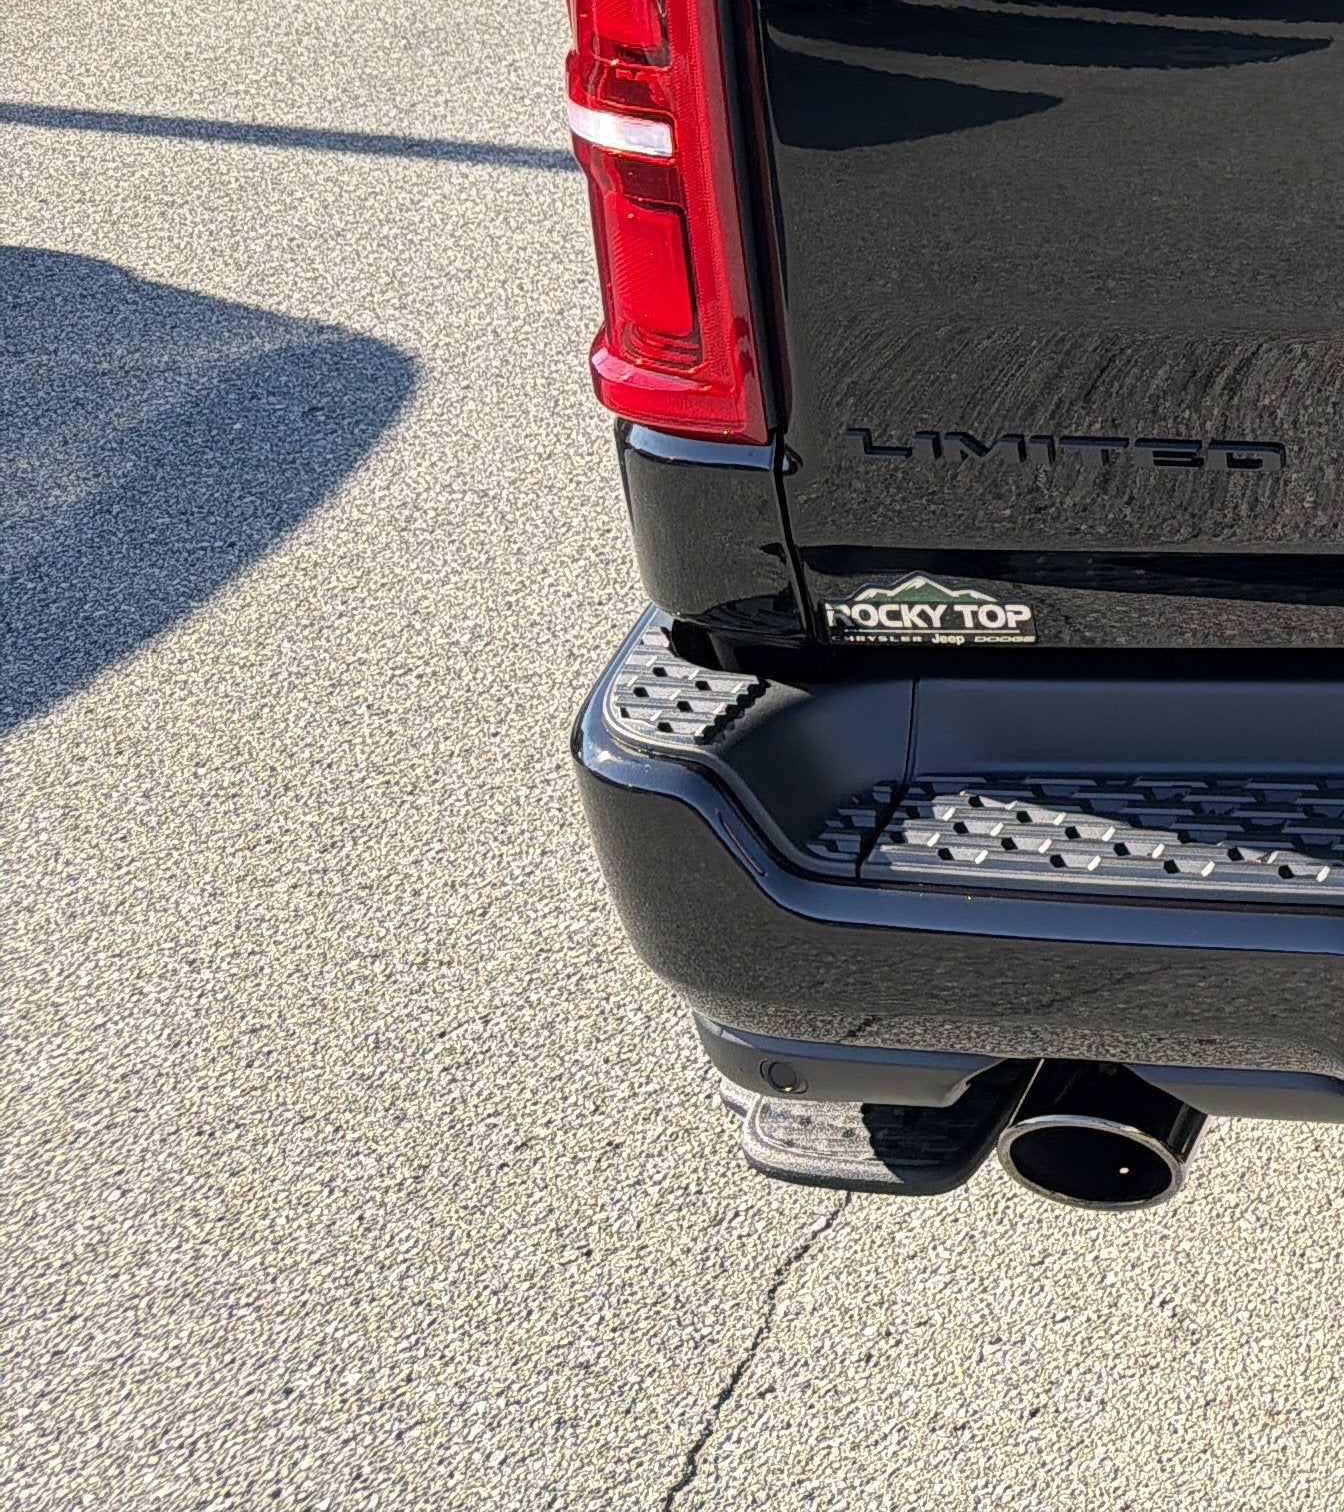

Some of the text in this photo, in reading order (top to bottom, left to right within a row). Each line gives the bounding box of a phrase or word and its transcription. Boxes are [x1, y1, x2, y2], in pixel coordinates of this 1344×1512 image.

[845, 427, 1287, 471] LIMITED
[824, 603, 1032, 628] ROCKY TOP
[831, 633, 1036, 646] CHRYSLER Jeep DODGE
